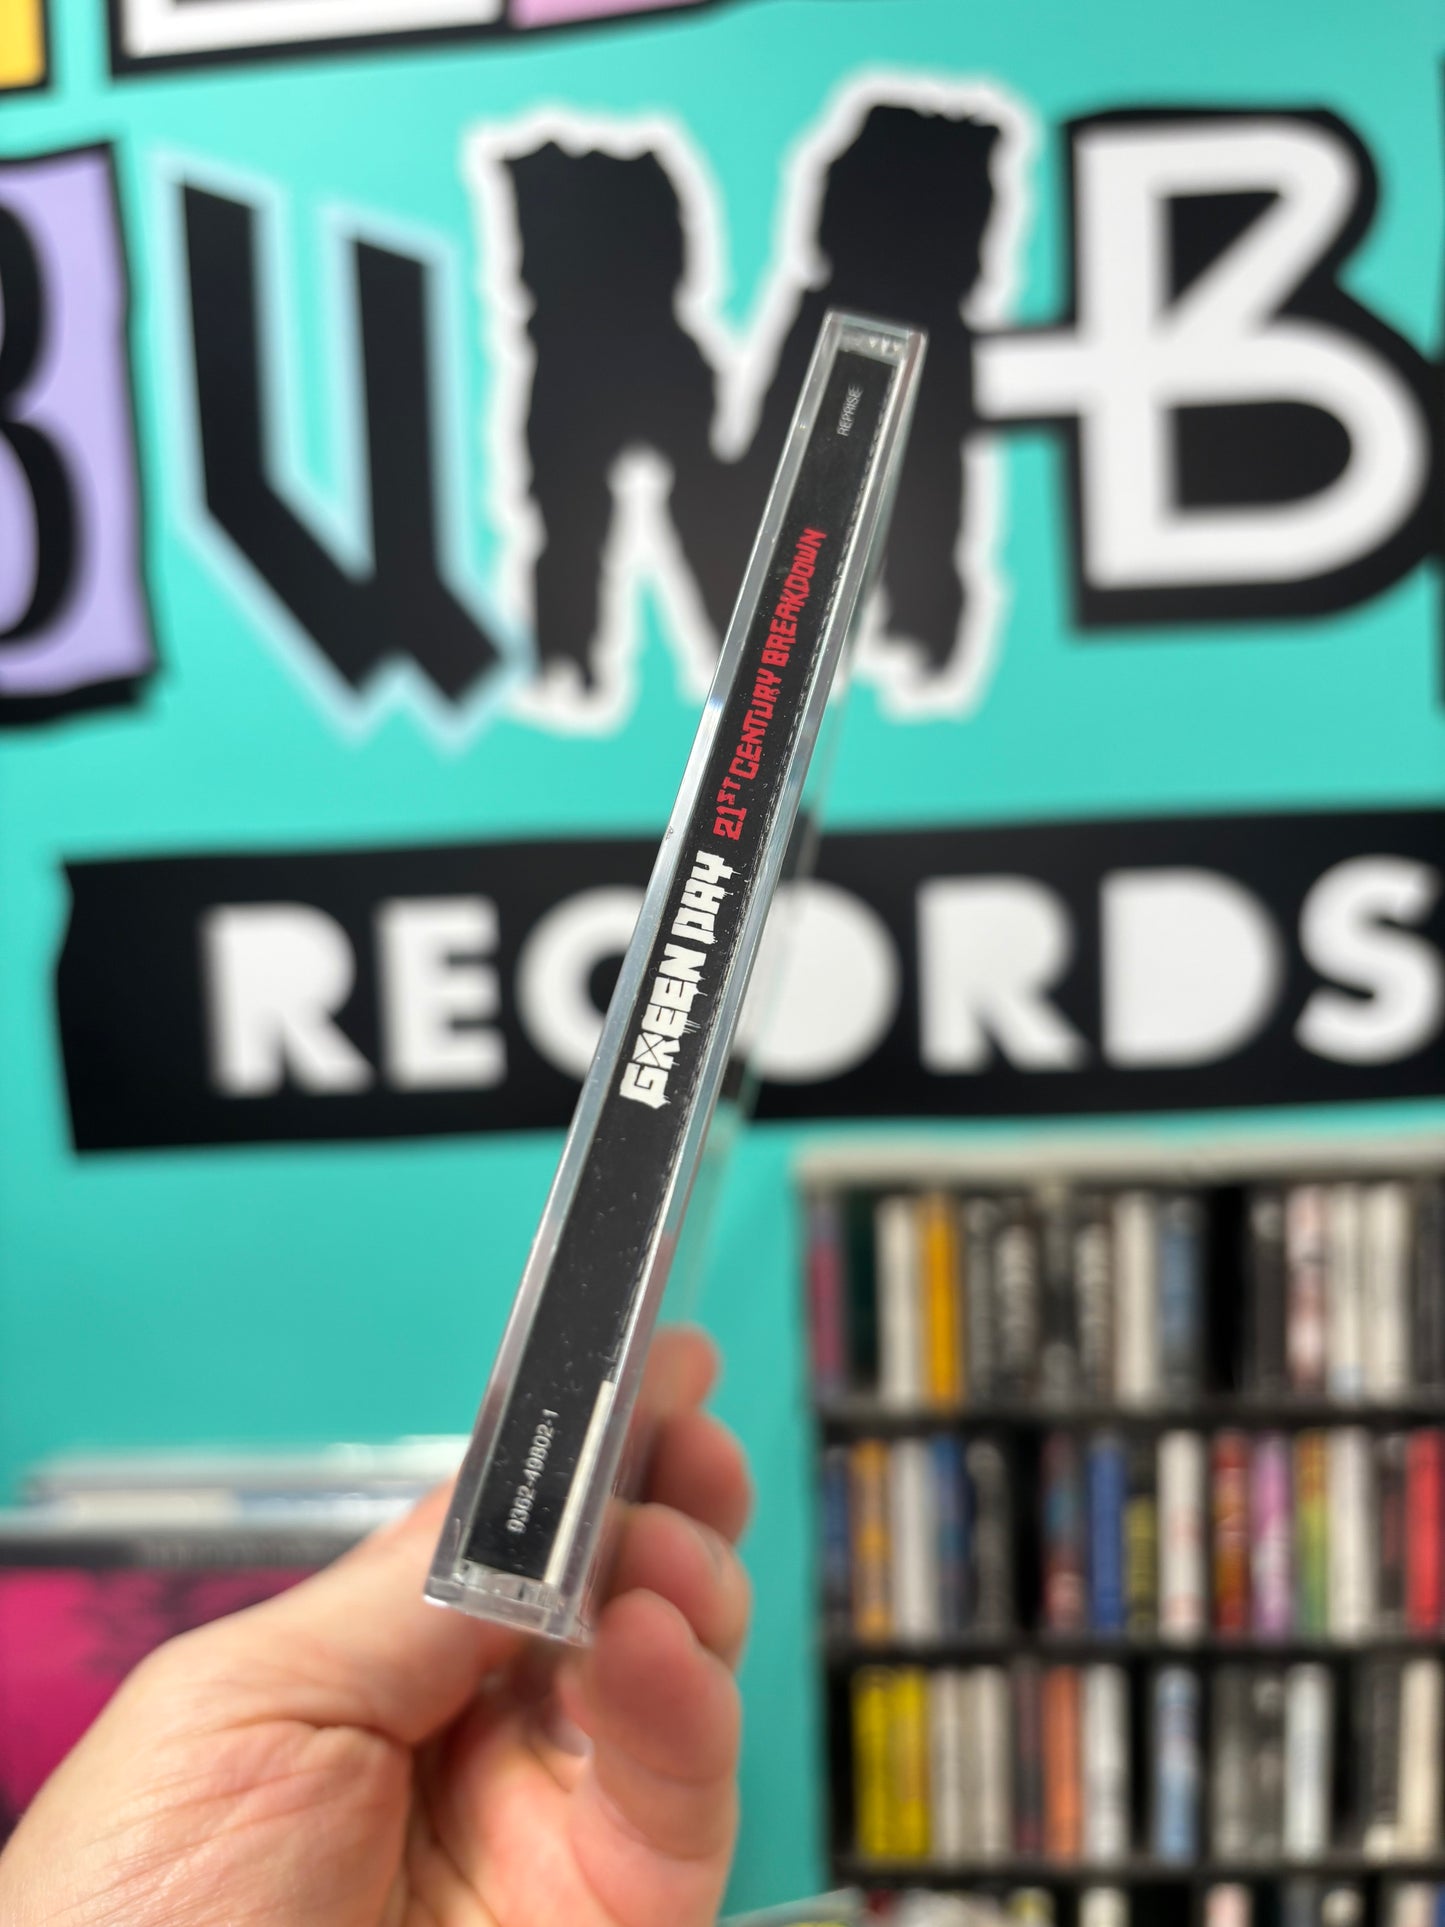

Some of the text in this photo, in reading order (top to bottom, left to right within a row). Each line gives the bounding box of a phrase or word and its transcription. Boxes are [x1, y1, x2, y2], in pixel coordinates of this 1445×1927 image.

[837, 384, 863, 437] REPRISE
[713, 526, 825, 841] 21ST CENTURY BREAKDOWN
[619, 851, 740, 1109] GREEN DAY
[506, 1408, 559, 1535] 9362-49802-1
